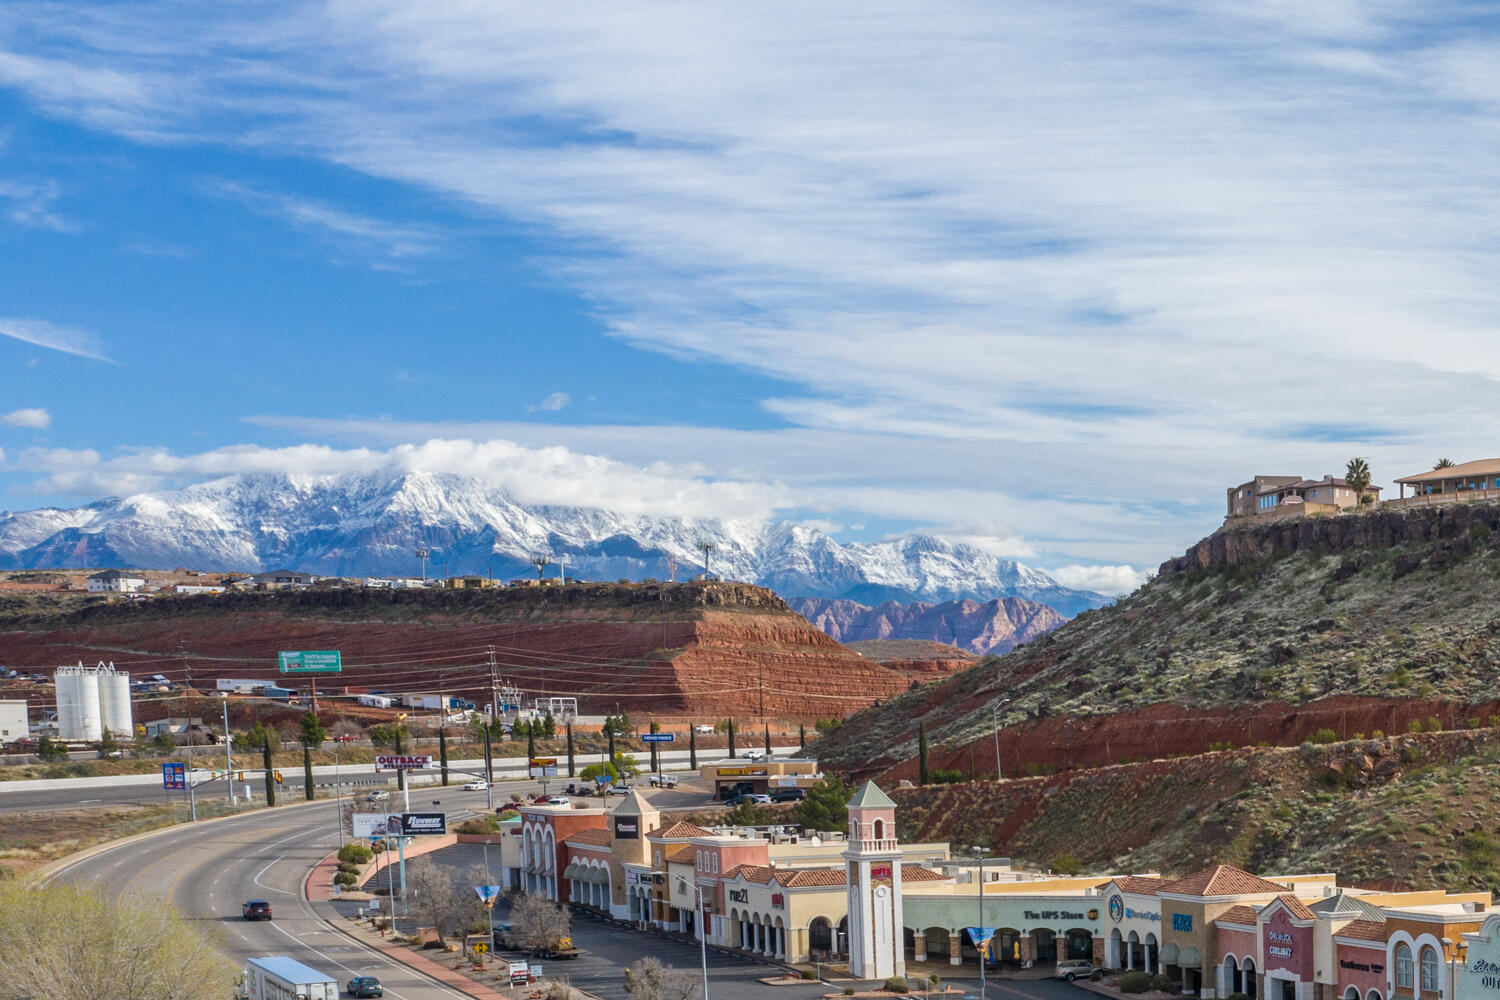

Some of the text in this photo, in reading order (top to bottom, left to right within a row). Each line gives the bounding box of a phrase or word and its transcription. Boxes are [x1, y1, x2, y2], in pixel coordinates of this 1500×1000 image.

[378, 756, 429, 764] OUTBACK
[729, 888, 749, 904] rue21
[1024, 910, 1040, 920] The
[1041, 910, 1059, 920] UPS
[1060, 910, 1084, 920] Store
